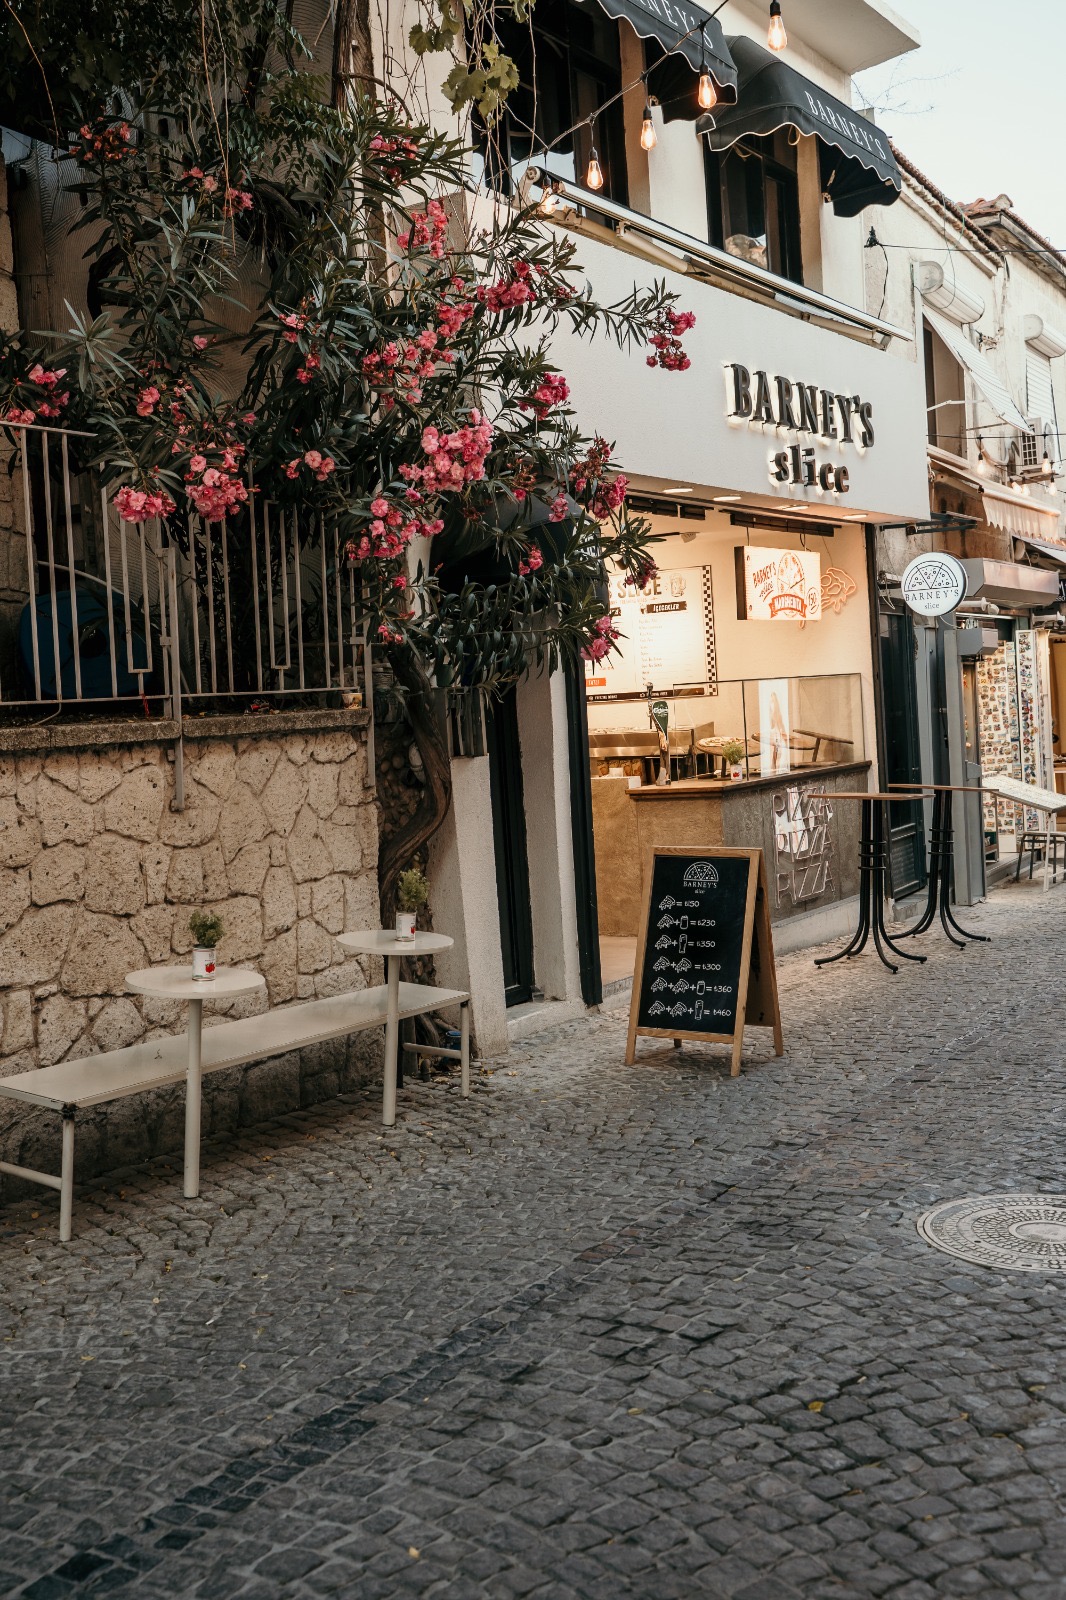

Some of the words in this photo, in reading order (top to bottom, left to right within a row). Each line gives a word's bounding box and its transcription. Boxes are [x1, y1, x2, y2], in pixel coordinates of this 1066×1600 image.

[804, 90, 887, 160] BARNEY'S
[730, 363, 875, 448] BARNEY'S
[773, 444, 850, 493] slice
[617, 577, 662, 598] SLCE
[904, 589, 959, 602] BARNEY'S
[924, 602, 940, 610] slice
[683, 881, 718, 889] BARNEY'S
